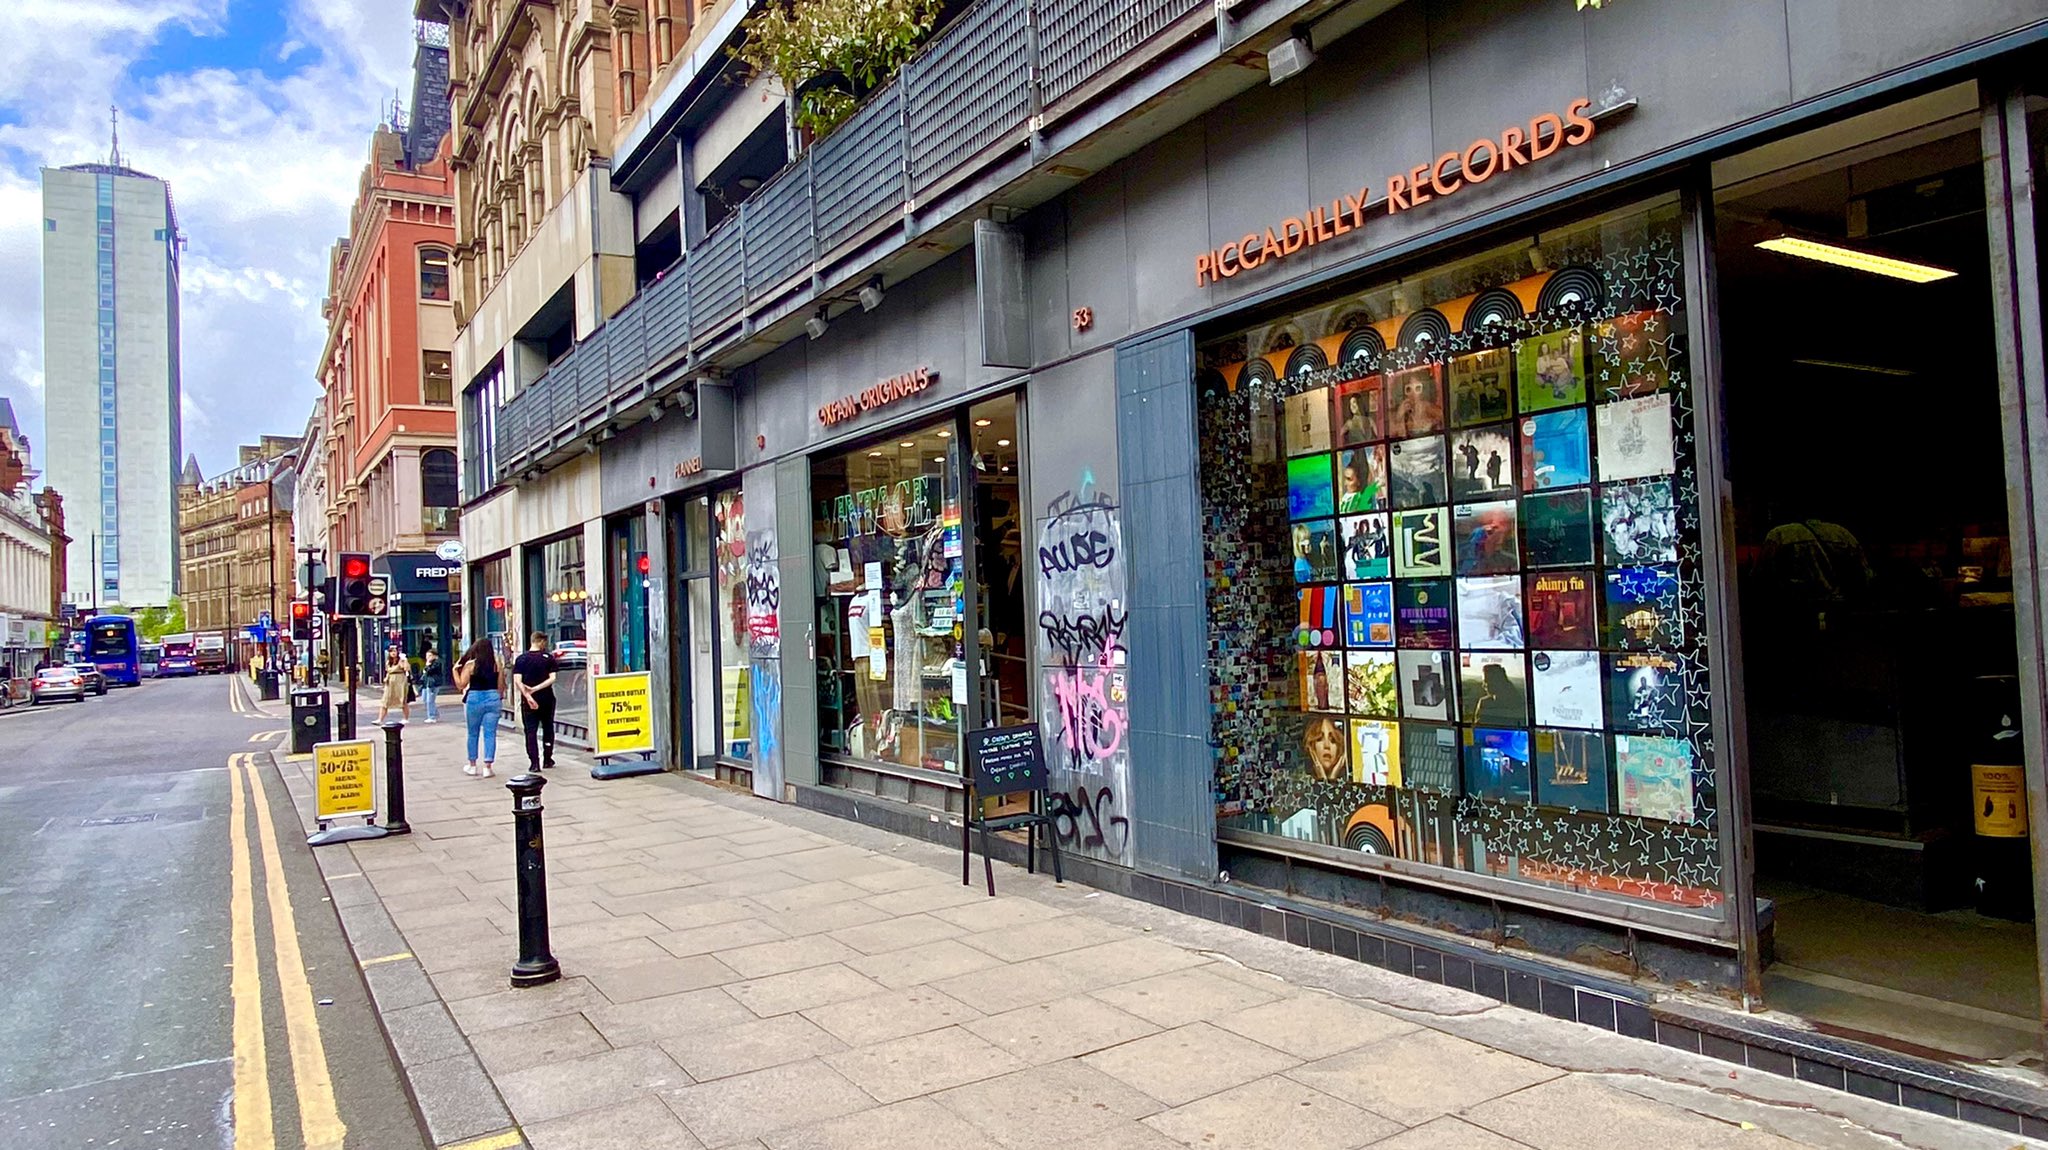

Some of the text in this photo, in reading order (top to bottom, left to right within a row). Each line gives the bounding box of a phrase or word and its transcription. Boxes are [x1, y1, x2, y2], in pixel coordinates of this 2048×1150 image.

[1195, 97, 1594, 287] PICCADILLY RECORDS
[1073, 307, 1090, 329] 53
[817, 366, 929, 427] OXFAM ORIGINALS
[415, 567, 447, 578] FRED
[599, 690, 625, 699] DESIGNER
[611, 701, 632, 713] 75%
